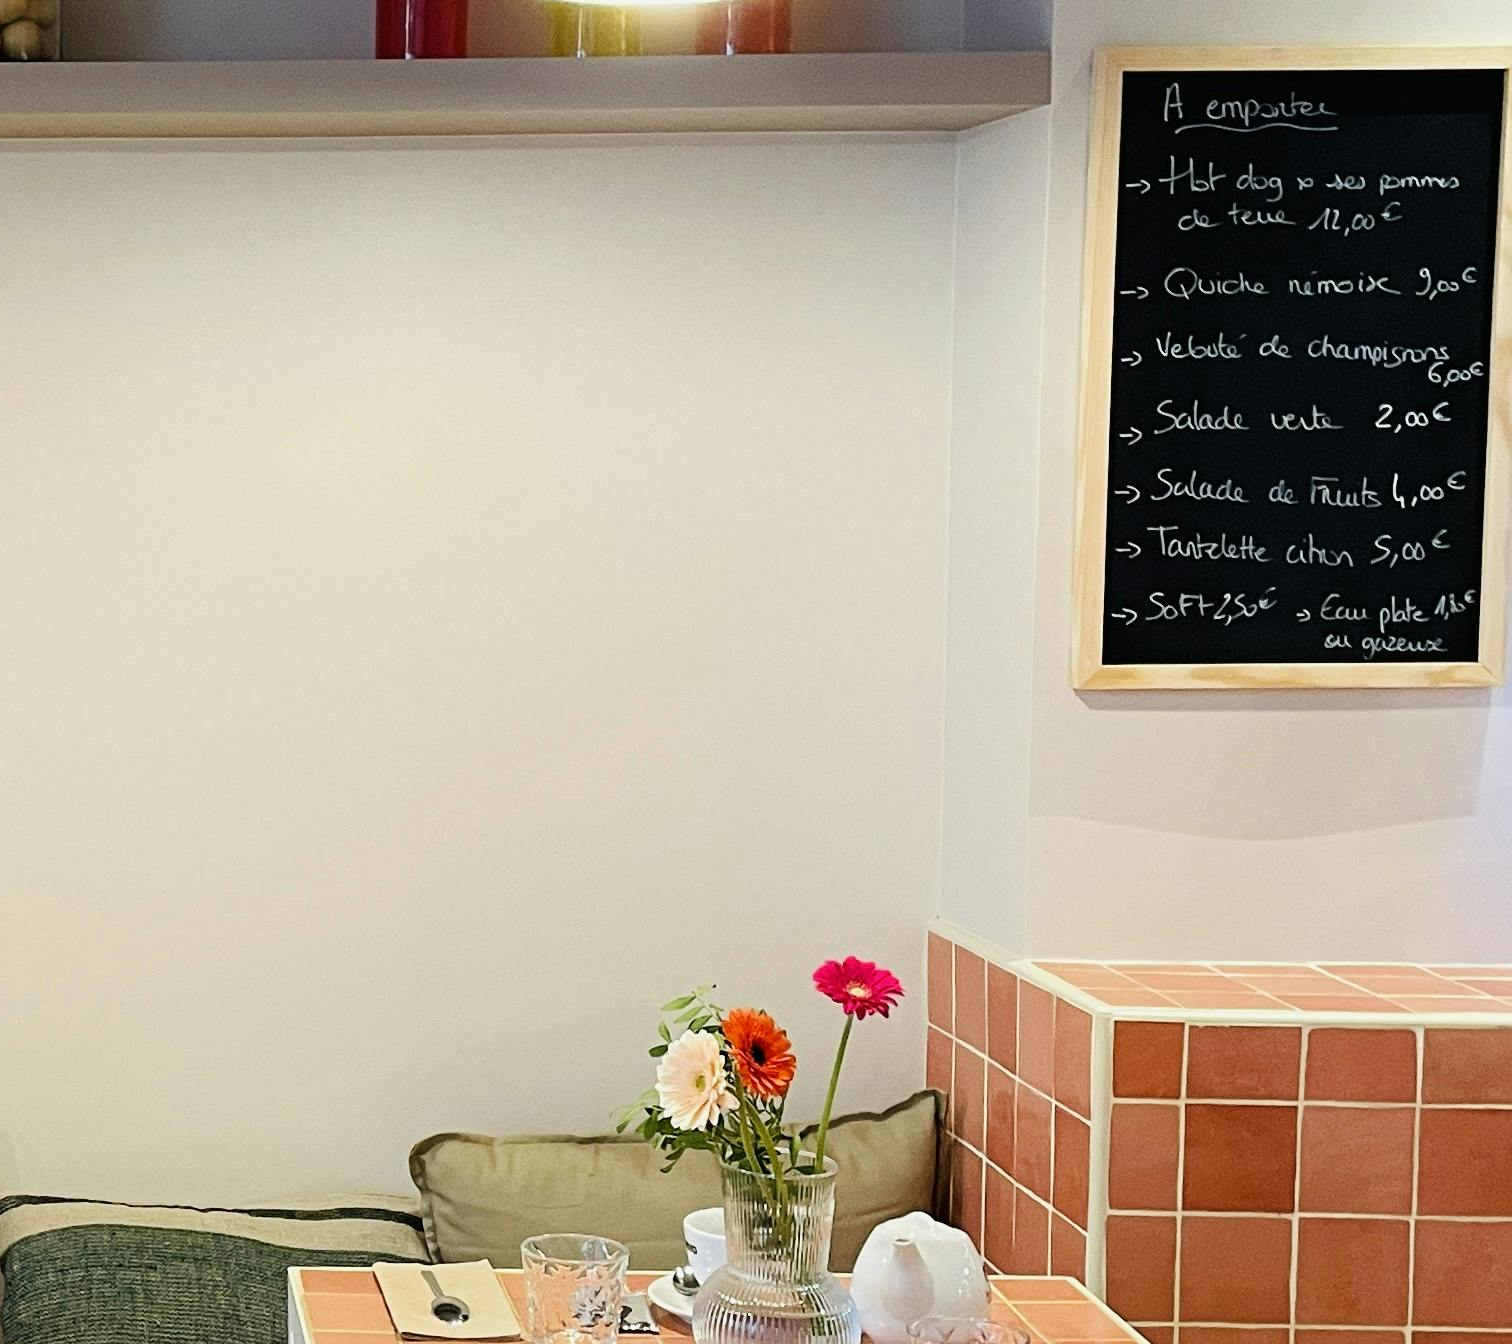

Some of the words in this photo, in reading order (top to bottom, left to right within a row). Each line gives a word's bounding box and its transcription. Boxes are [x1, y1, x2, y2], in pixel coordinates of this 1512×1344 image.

[1205, 91, 1338, 127] emporter
[1158, 155, 1227, 195] Hot
[1236, 162, 1283, 203] dog
[1325, 173, 1366, 190] ses
[1379, 174, 1460, 196] pommes
[1178, 208, 1223, 231] de
[1164, 267, 1270, 301] Quiche
[1156, 331, 1248, 359] Velouté
[1259, 334, 1292, 358] de
[1307, 334, 1450, 368] champignons
[1153, 399, 1251, 434] Salade
[1270, 404, 1344, 431] verte
[1150, 467, 1251, 501] Salade
[1268, 479, 1299, 504] de
[1146, 525, 1273, 562] Tartelette
[1285, 532, 1354, 568] citron
[1320, 593, 1370, 621] Eau
[1379, 595, 1432, 634] plate
[1323, 633, 1353, 649] ou
[1361, 634, 1449, 661] gazeuse
